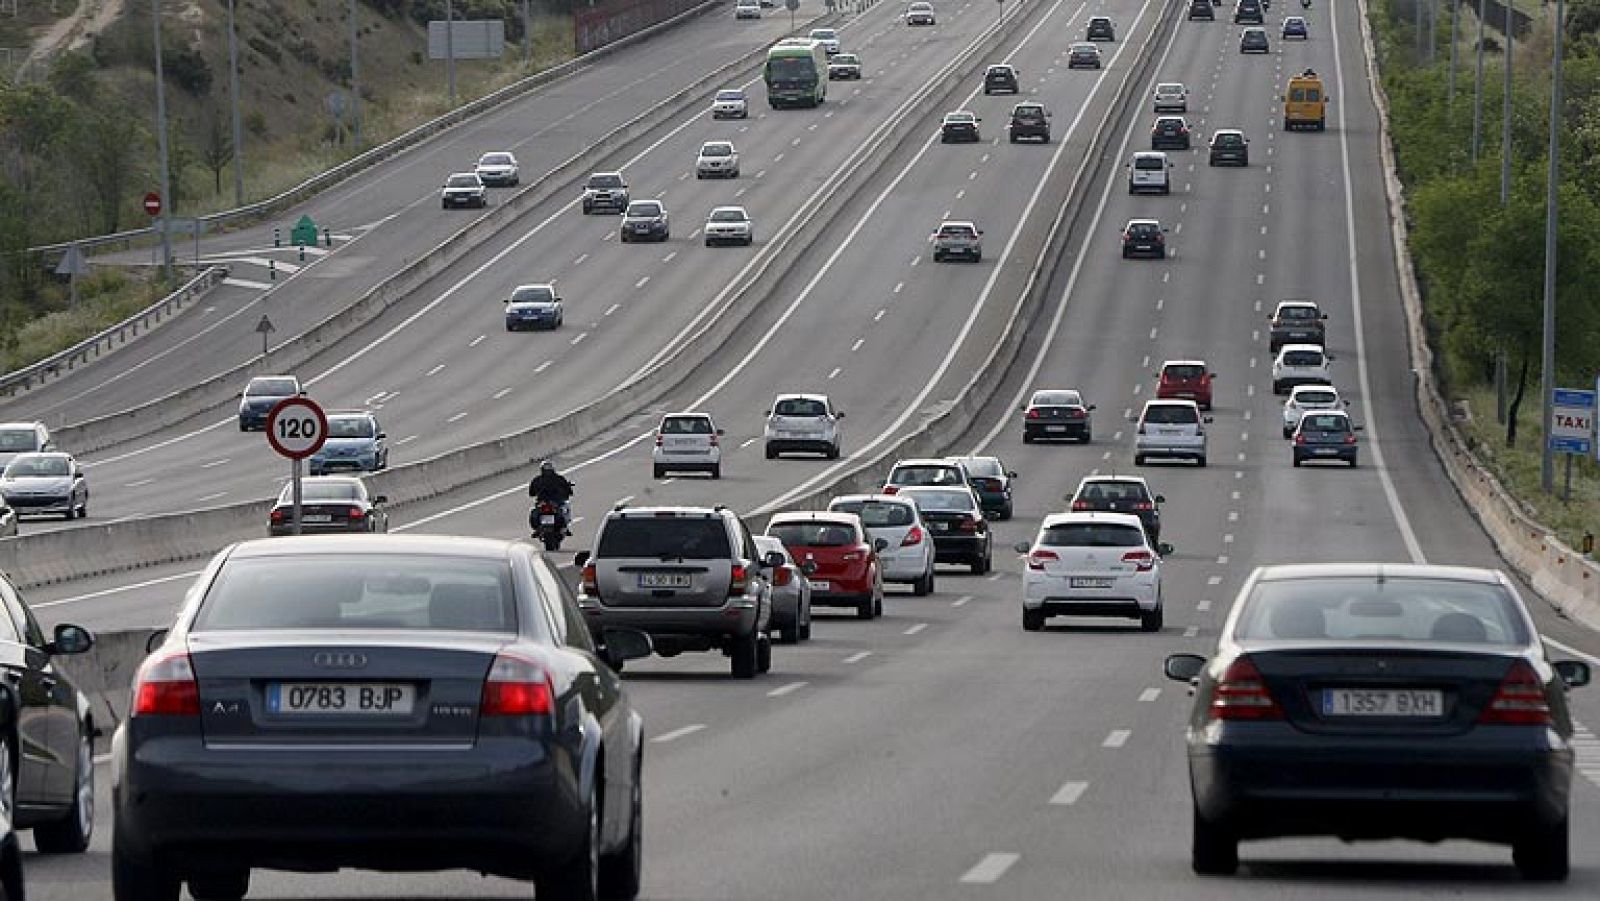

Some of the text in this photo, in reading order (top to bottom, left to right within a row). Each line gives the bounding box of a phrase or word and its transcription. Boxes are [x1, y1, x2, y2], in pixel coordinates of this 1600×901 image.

[279, 418, 316, 439] 120
[1555, 414, 1591, 430] TAXI
[289, 687, 404, 710] 0783 BJP
[1342, 693, 1388, 712] 1357
